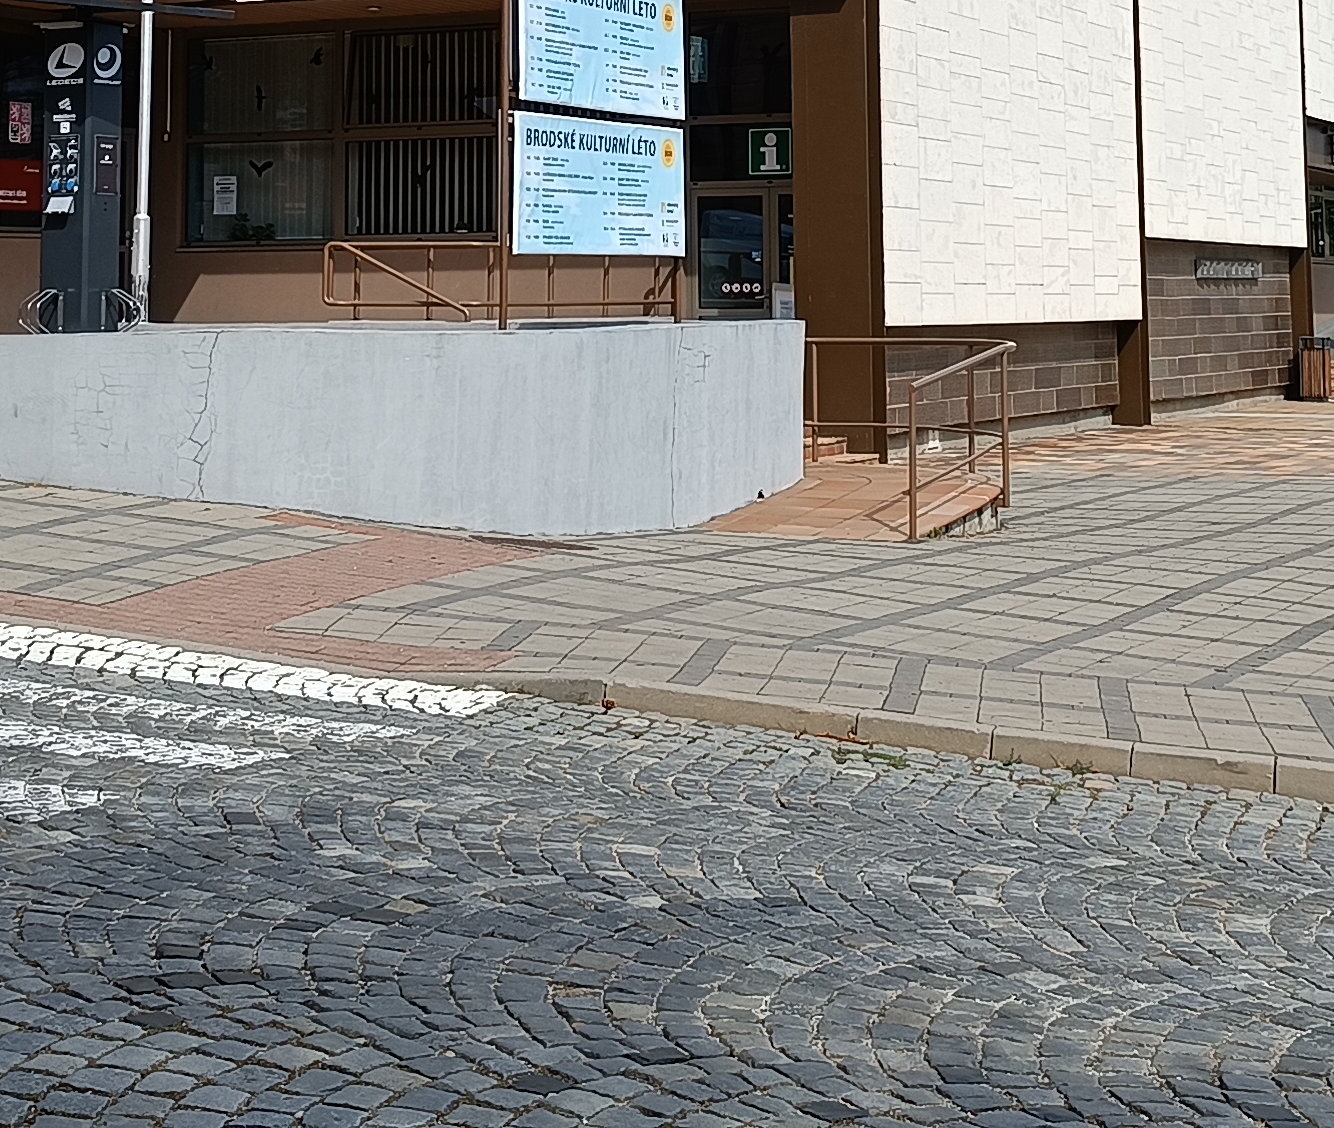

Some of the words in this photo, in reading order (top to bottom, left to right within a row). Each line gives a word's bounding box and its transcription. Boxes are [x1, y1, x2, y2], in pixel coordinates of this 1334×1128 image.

[526, 128, 576, 150] BRODSKÉ
[578, 133, 631, 155] KULTURNÍ
[631, 135, 657, 157] LÉTO
